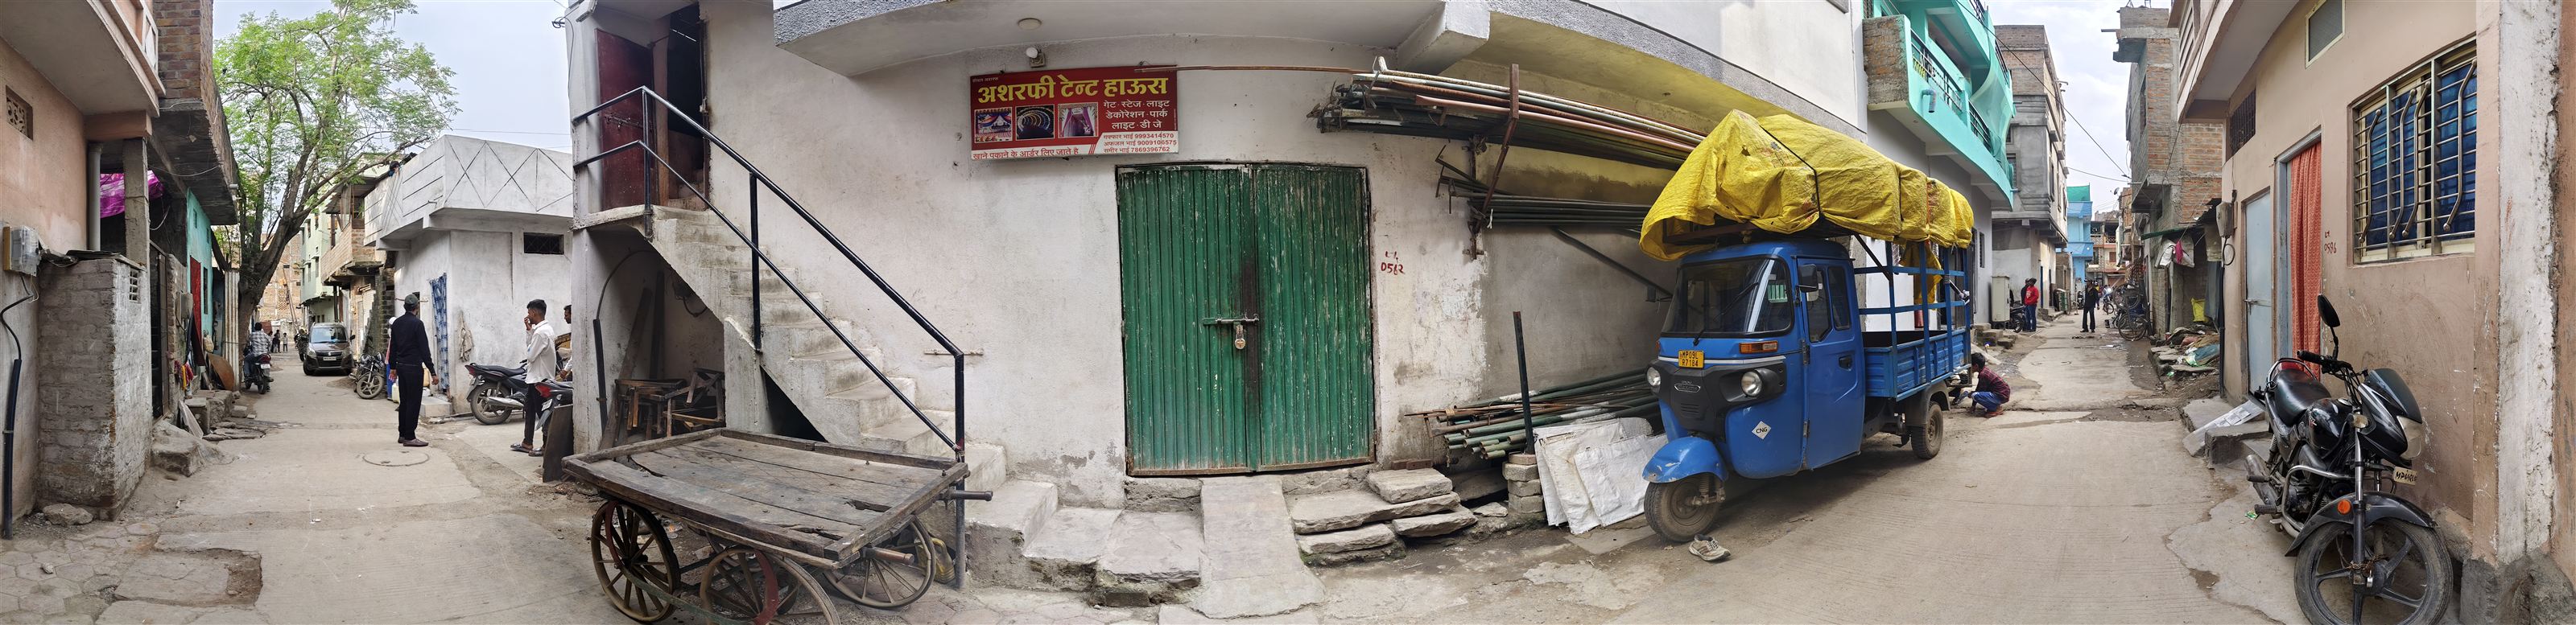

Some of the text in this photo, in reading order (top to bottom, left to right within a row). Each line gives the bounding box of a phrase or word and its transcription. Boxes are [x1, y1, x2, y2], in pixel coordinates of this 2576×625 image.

[978, 74, 1169, 103] अशरफी टेन्ट हाऊस
[1104, 99, 1170, 108] गेट स्टेज लाइट
[1105, 109, 1168, 119] डेकोरेशन पार्क
[1112, 121, 1135, 130] लाइट
[1140, 119, 1150, 129] डी
[1153, 119, 1162, 128] जे
[1137, 139, 1177, 147] 9009106575
[989, 151, 1009, 159] पकाने
[1020, 148, 1039, 158] आर्डर
[1041, 148, 1055, 156] लिए
[1056, 146, 1071, 155] जाते
[1682, 351, 1699, 360] MP09L
